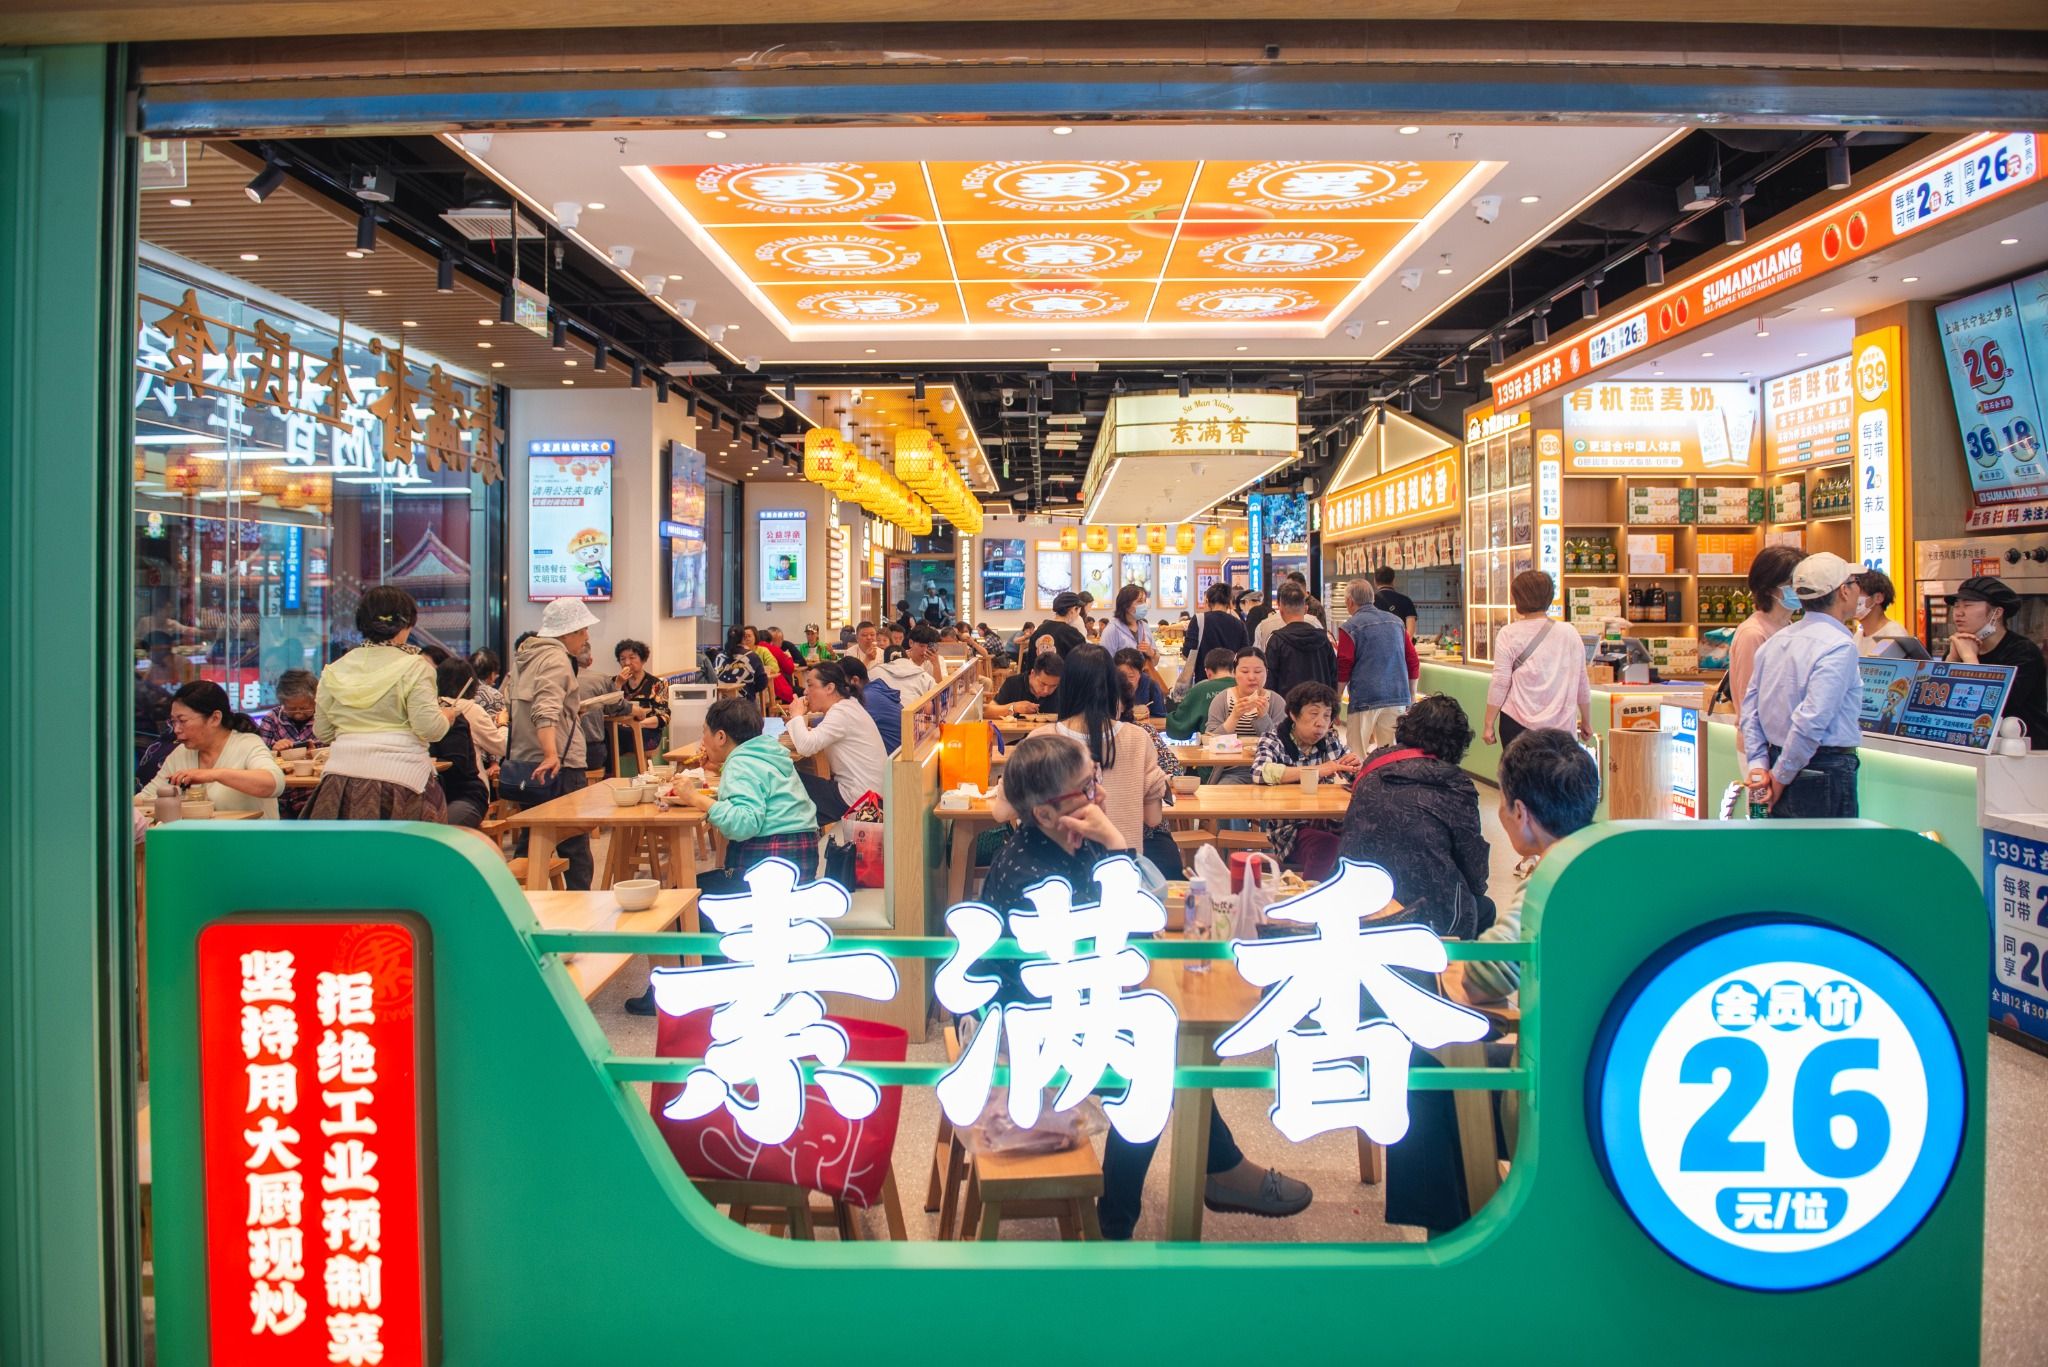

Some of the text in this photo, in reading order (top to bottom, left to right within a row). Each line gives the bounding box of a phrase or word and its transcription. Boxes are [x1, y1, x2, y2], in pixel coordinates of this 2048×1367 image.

[1917, 182, 1931, 219] 2
[1964, 160, 1977, 198] 同享
[1978, 146, 2008, 189] 26
[1074, 233, 1125, 244] DIET
[1197, 231, 1355, 258] VEGETARIAN DIET
[1703, 242, 1802, 306] SUMANXIANG
[1715, 295, 1737, 310] PEOPLE
[1736, 275, 1776, 301] VEGETARIAN
[1777, 264, 1802, 283] BUFFET
[1624, 322, 1638, 346] 26
[1858, 360, 1886, 392] 139
[1963, 339, 2005, 390] 26
[1497, 357, 1562, 407] 139元会员年卡
[1183, 399, 1235, 415] Su Man Xiang
[1569, 386, 1717, 412] 有机燕麦奶
[1170, 416, 1251, 445] 素满香
[1967, 427, 1996, 460] 36
[1863, 441, 1883, 460] 可带
[532, 485, 604, 496] 请用公共夹取餐
[1866, 465, 1875, 490] 2
[1864, 496, 1884, 513] 亲友
[1985, 487, 2038, 502] SUMANXIANG
[1544, 545, 1551, 554] 2
[1864, 536, 1885, 554] 同享
[533, 564, 567, 574] 围绕餐台
[533, 574, 567, 584] 文明取餐
[1919, 681, 1949, 707] 139
[2003, 876, 2031, 900] 每餐
[2004, 899, 2031, 922] 可带
[2003, 934, 2016, 977] 同享
[649, 856, 1493, 1147] 素满香
[1713, 984, 1859, 1026] 会员价
[1992, 987, 2048, 1021] 全国12省30
[1679, 1036, 1891, 1179] 26
[239, 949, 308, 1336] 坚持用大厨现炒
[316, 970, 384, 1367] 拒绝工业预制菜
[1734, 1192, 1829, 1231] 元/位
